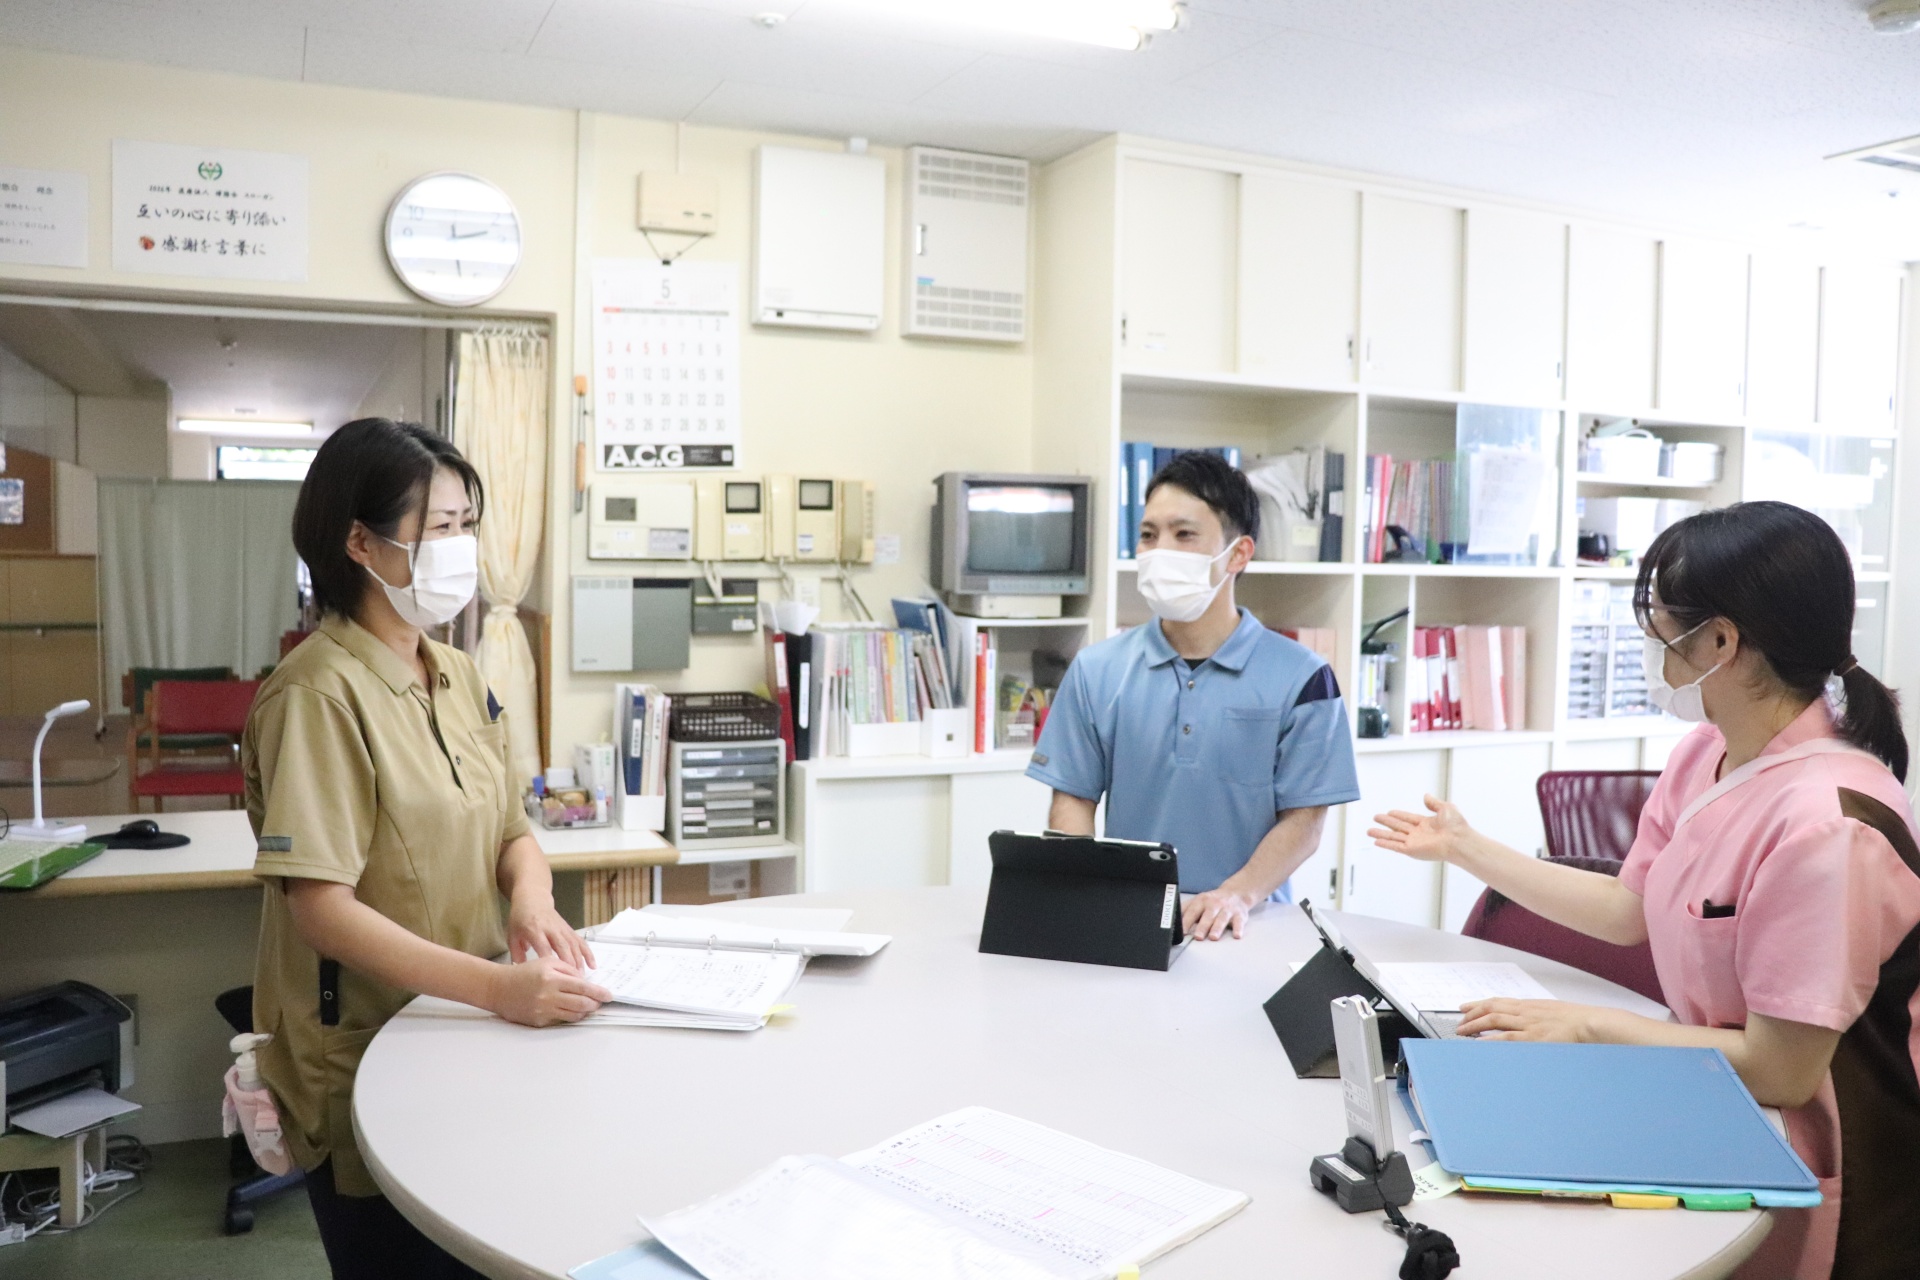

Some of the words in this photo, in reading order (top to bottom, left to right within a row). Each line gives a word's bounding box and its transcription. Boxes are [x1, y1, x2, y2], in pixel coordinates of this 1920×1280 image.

[137, 204, 287, 227] 互いの心に寄り添い
[162, 234, 267, 257] 感謝を言葉に
[661, 278, 671, 300] 5
[606, 367, 616, 380] 10
[625, 367, 634, 380] 11
[643, 367, 652, 380] 12
[661, 368, 671, 380] 13
[679, 369, 689, 380] 14
[697, 368, 707, 381] 15
[715, 369, 724, 382] 16
[607, 393, 616, 405] 17
[625, 393, 634, 405] 18
[643, 393, 653, 405] 19
[661, 393, 671, 406] 20
[679, 393, 689, 406] 21
[697, 394, 707, 406] 22
[715, 394, 725, 407] 23
[625, 418, 635, 431] 25
[643, 418, 653, 431] 26
[661, 419, 672, 431] 27
[679, 419, 690, 432] 28
[697, 419, 707, 432] 29
[715, 419, 726, 432] 30
